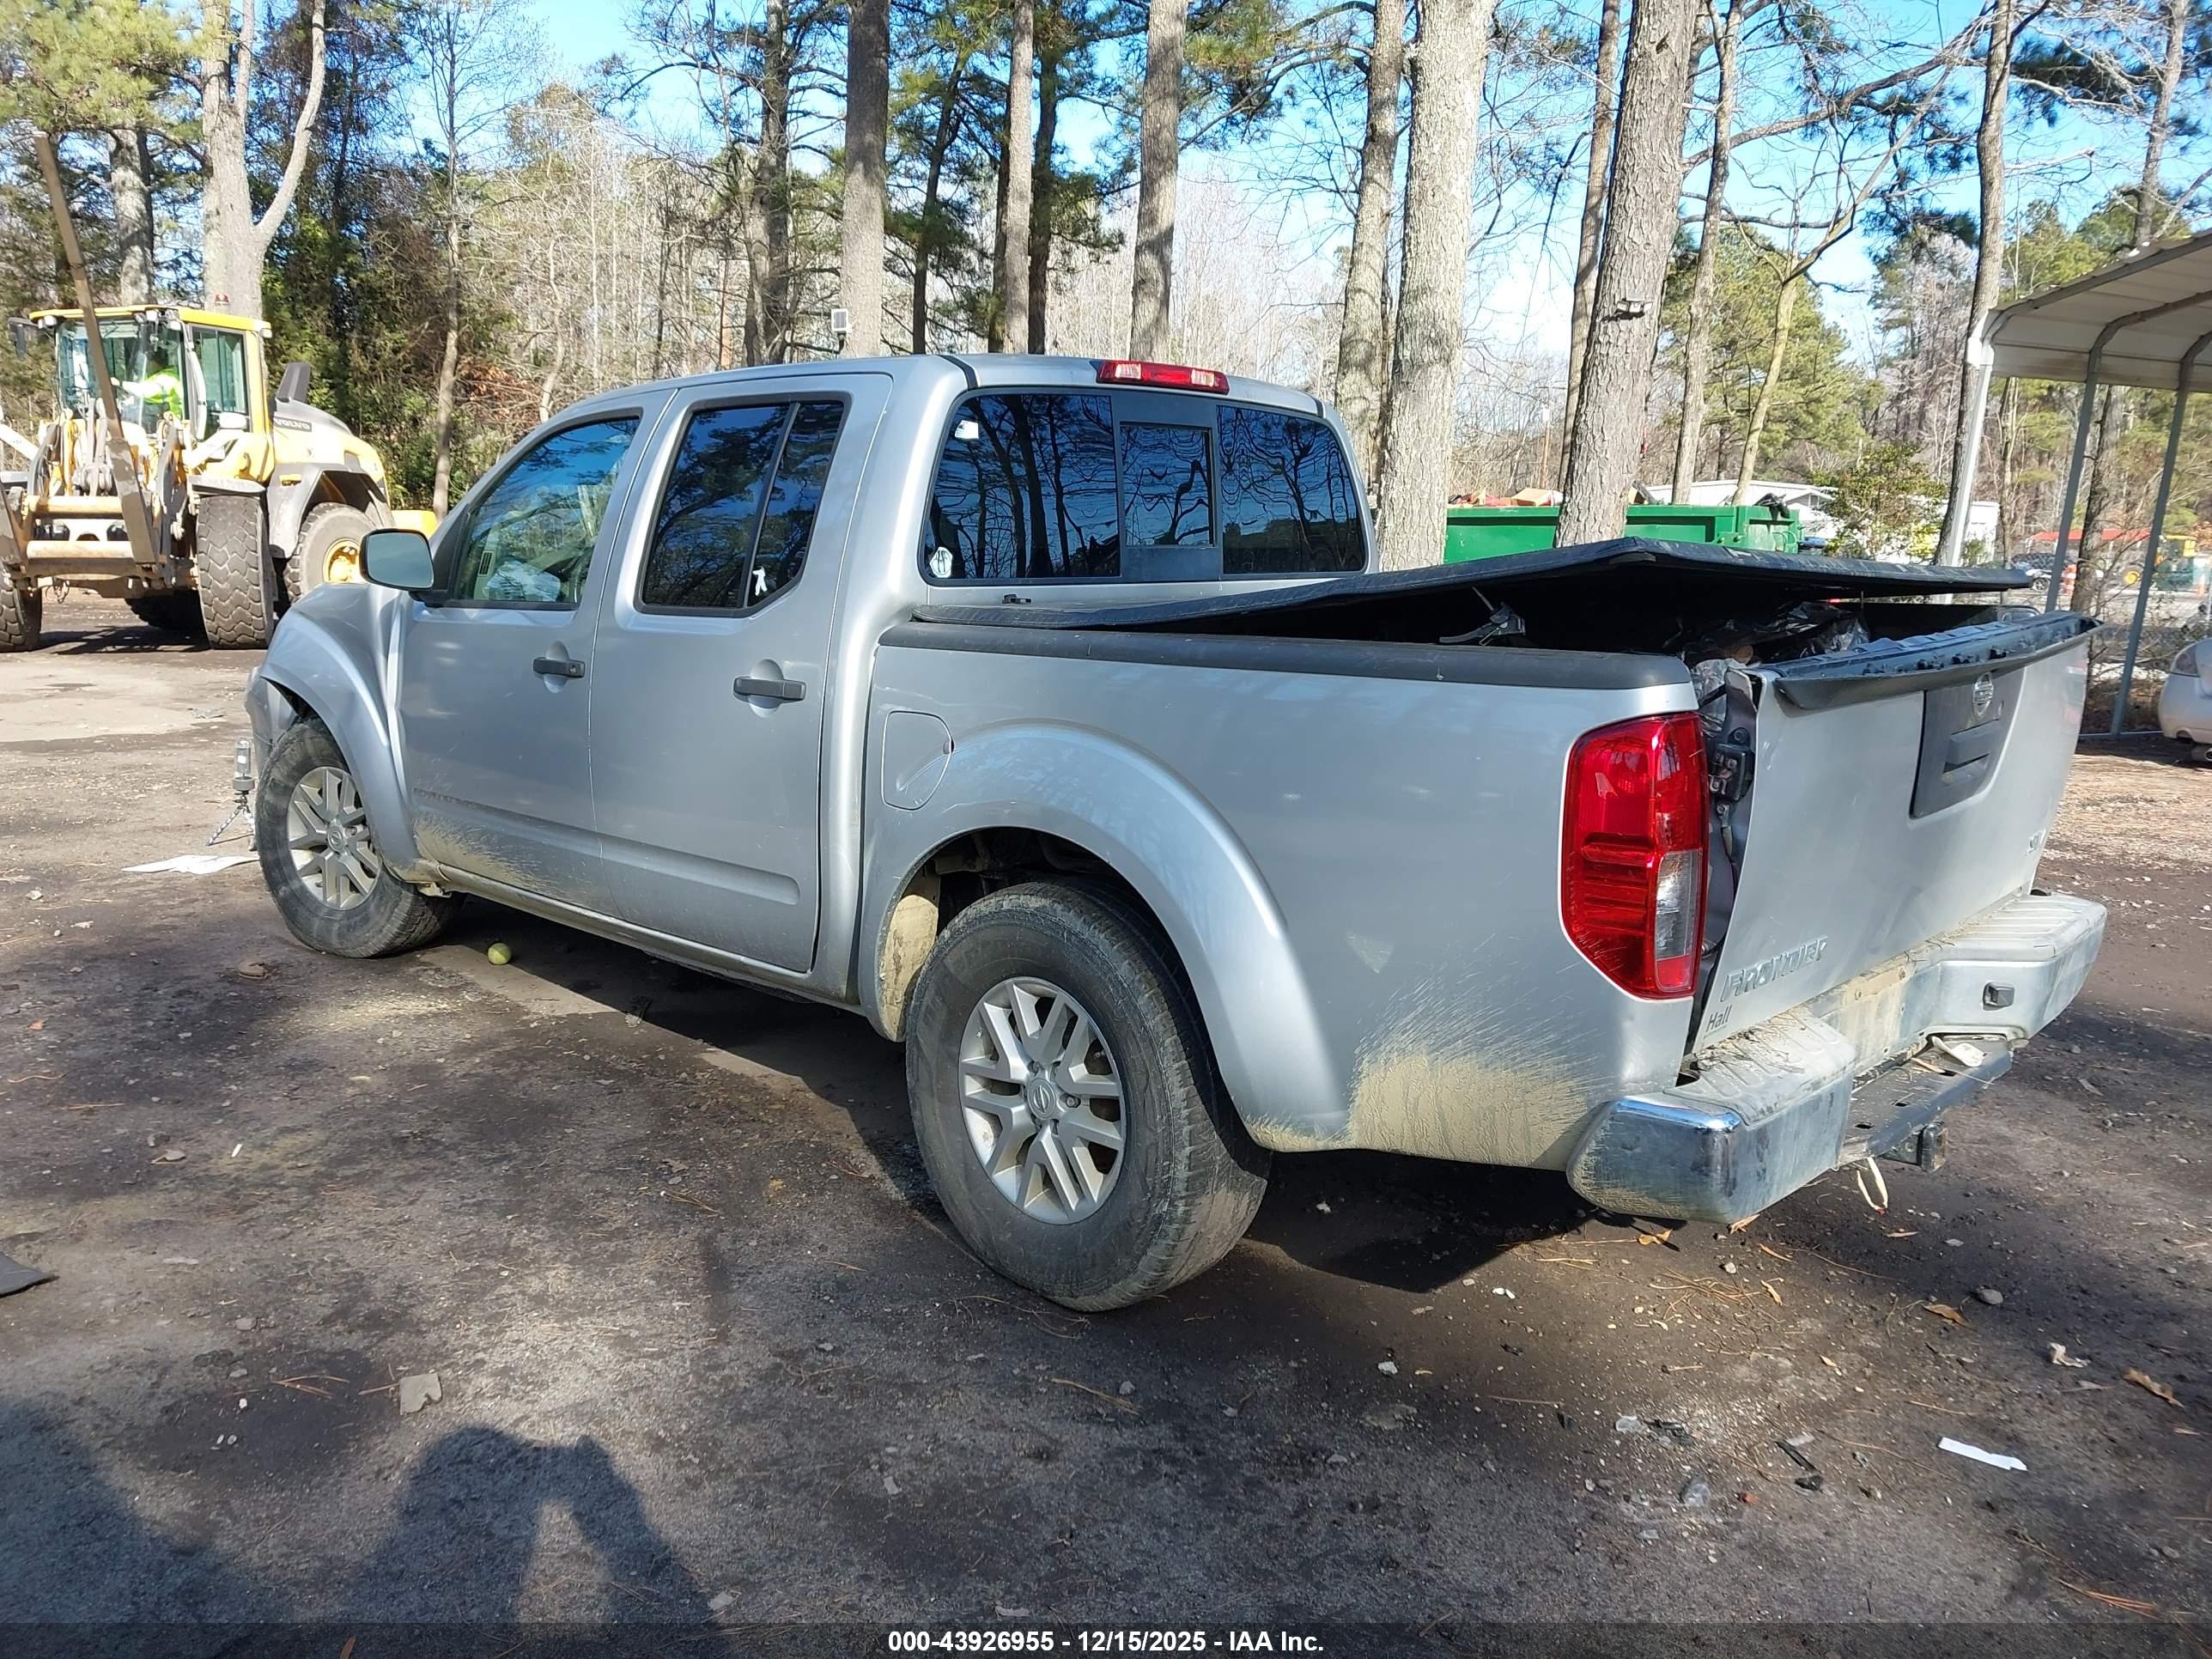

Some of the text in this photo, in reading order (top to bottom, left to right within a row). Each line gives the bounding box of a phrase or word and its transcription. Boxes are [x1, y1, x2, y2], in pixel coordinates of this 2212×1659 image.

[274, 417, 311, 430] VOLVO
[1720, 935, 1828, 1002] FRONTIER
[1705, 1004, 1732, 1032] Hall
